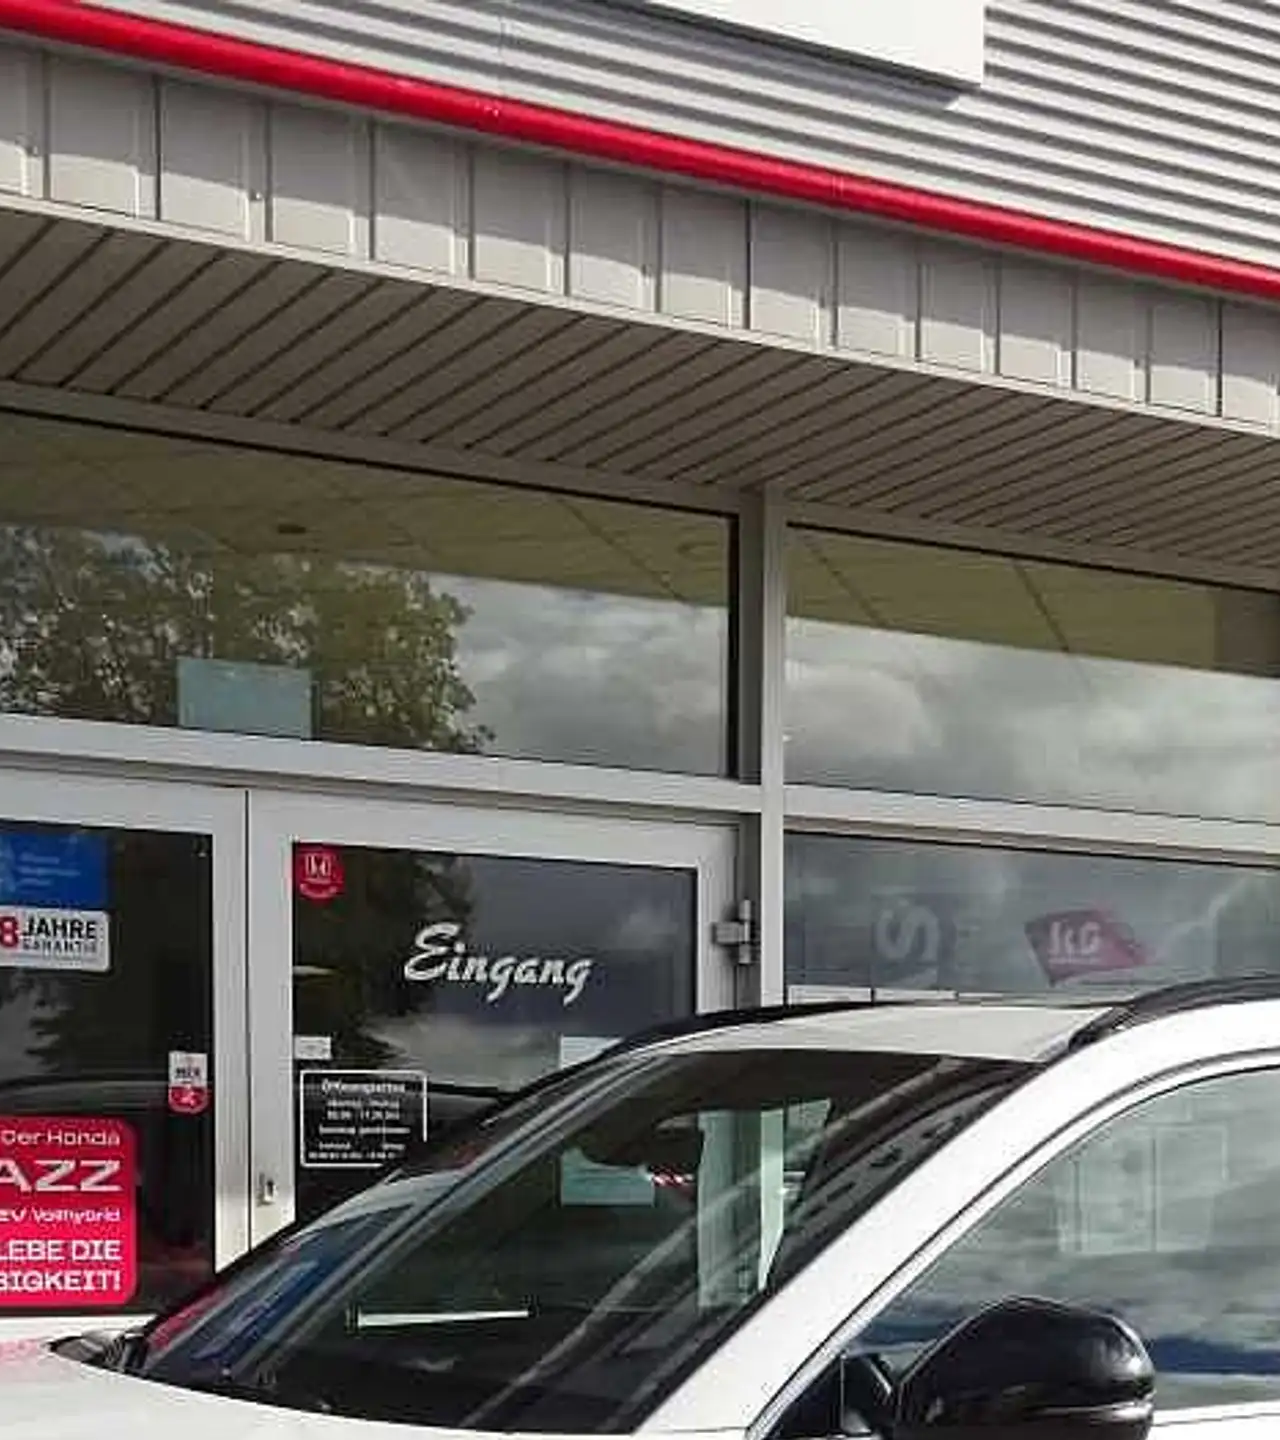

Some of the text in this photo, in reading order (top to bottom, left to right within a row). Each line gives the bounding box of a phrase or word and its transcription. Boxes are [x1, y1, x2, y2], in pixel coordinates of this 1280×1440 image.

[22, 915, 97, 940] JAHRE
[404, 922, 593, 1006] Eingang
[1, 1129, 121, 1146] Der Honda
[71, 1240, 123, 1262] DIE
